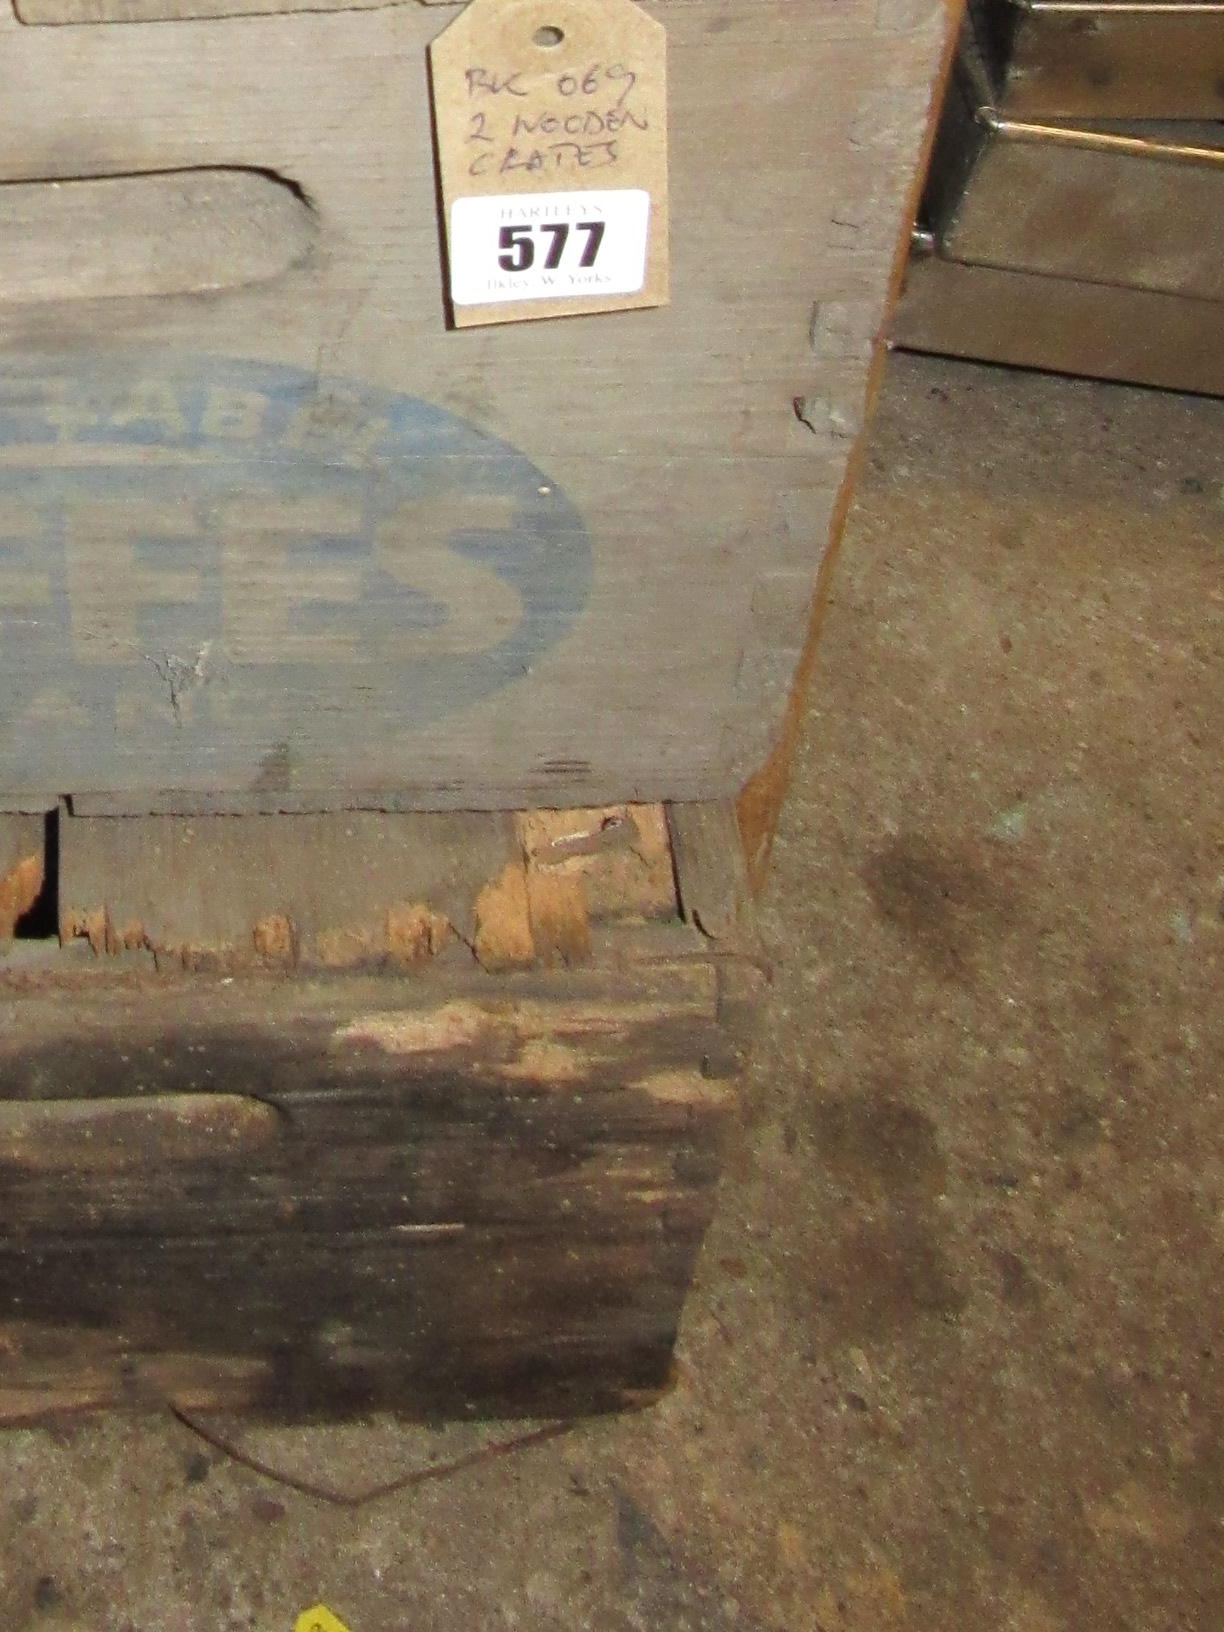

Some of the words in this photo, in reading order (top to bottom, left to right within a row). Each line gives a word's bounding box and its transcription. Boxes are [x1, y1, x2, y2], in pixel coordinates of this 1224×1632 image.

[469, 112, 495, 143] 2
[468, 140, 619, 176] CRATES
[497, 220, 606, 273] 577
